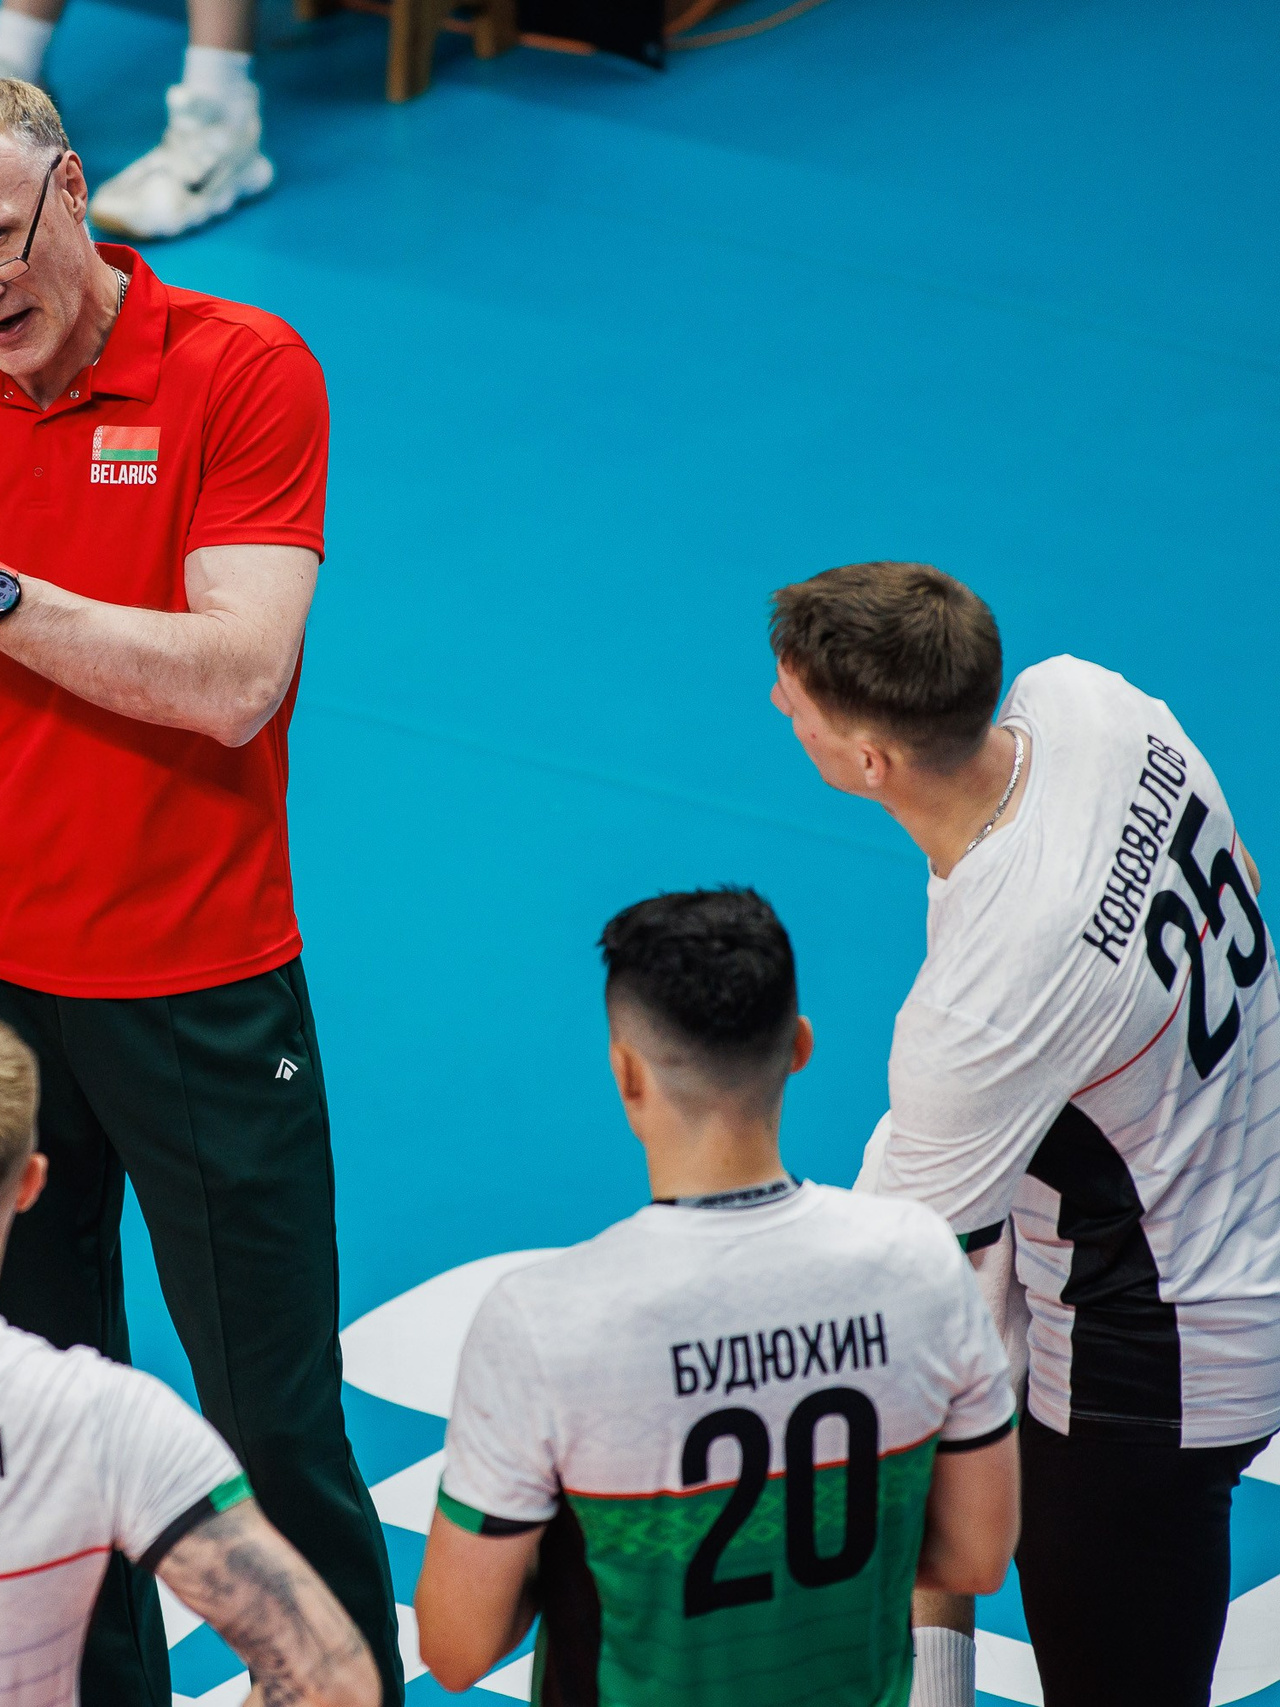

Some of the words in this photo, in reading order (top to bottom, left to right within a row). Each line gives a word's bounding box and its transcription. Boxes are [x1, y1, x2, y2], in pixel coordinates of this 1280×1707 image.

[90, 463, 158, 484] BELARUS
[1083, 734, 1187, 965] КОНОВАЛОВ
[1145, 792, 1267, 1080] 25
[672, 1312, 888, 1396] БУДЮХИН
[681, 1386, 878, 1619] 20
